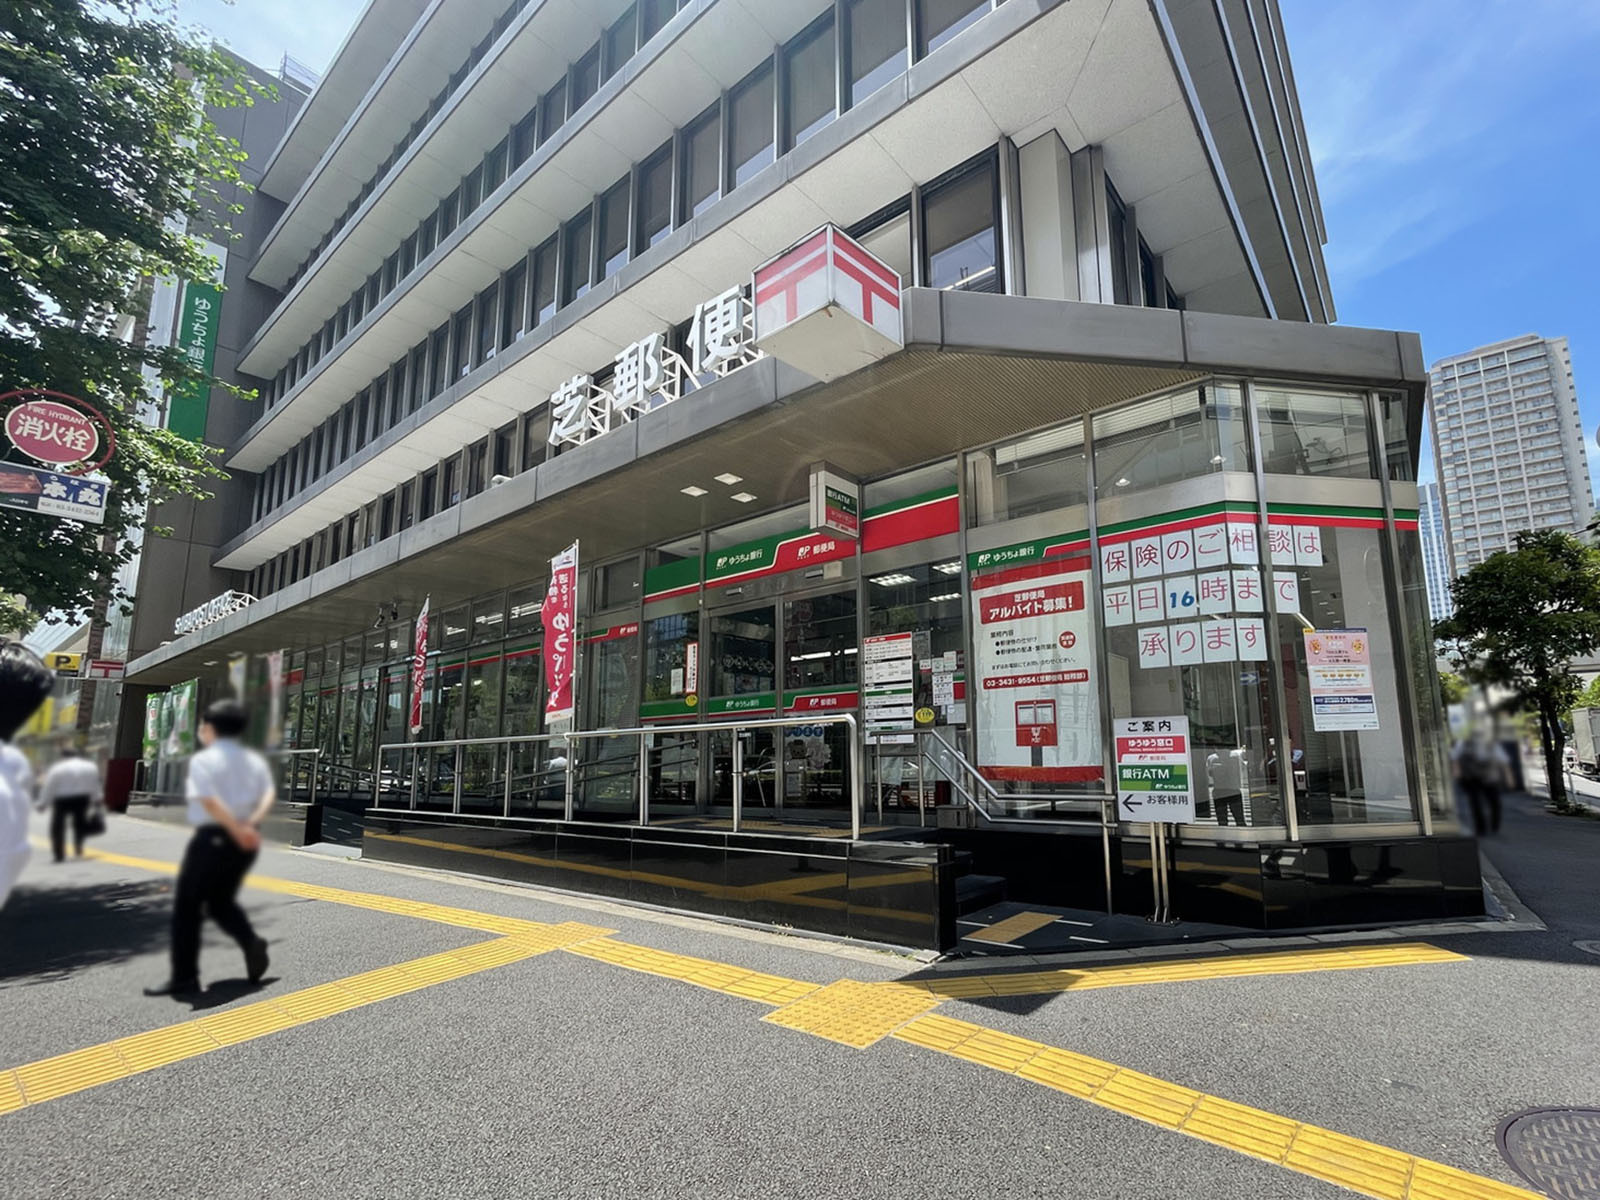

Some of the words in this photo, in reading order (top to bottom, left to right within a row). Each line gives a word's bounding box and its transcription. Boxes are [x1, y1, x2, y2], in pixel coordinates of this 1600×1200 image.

[27, 405, 46, 416] FIRE
[48, 410, 87, 426] HYDRANT
[15, 413, 91, 452] 消火栓
[813, 541, 836, 555] 郵便局
[993, 546, 1035, 561] ゆうちょ銀行
[1104, 527, 1319, 573] 保険のご相談は
[728, 549, 763, 566] ゆうちょ銀行
[1106, 576, 1295, 614] 平日16時まで
[989, 596, 1073, 620] アルバイト募集!
[1141, 624, 1262, 656] 承ります
[55, 655, 71, 669] P
[1128, 720, 1171, 732] ご案内
[1128, 738, 1174, 747] ゆうゆう窓口
[1122, 768, 1170, 779] 銀行ATM
[1146, 795, 1189, 805] お客様用
